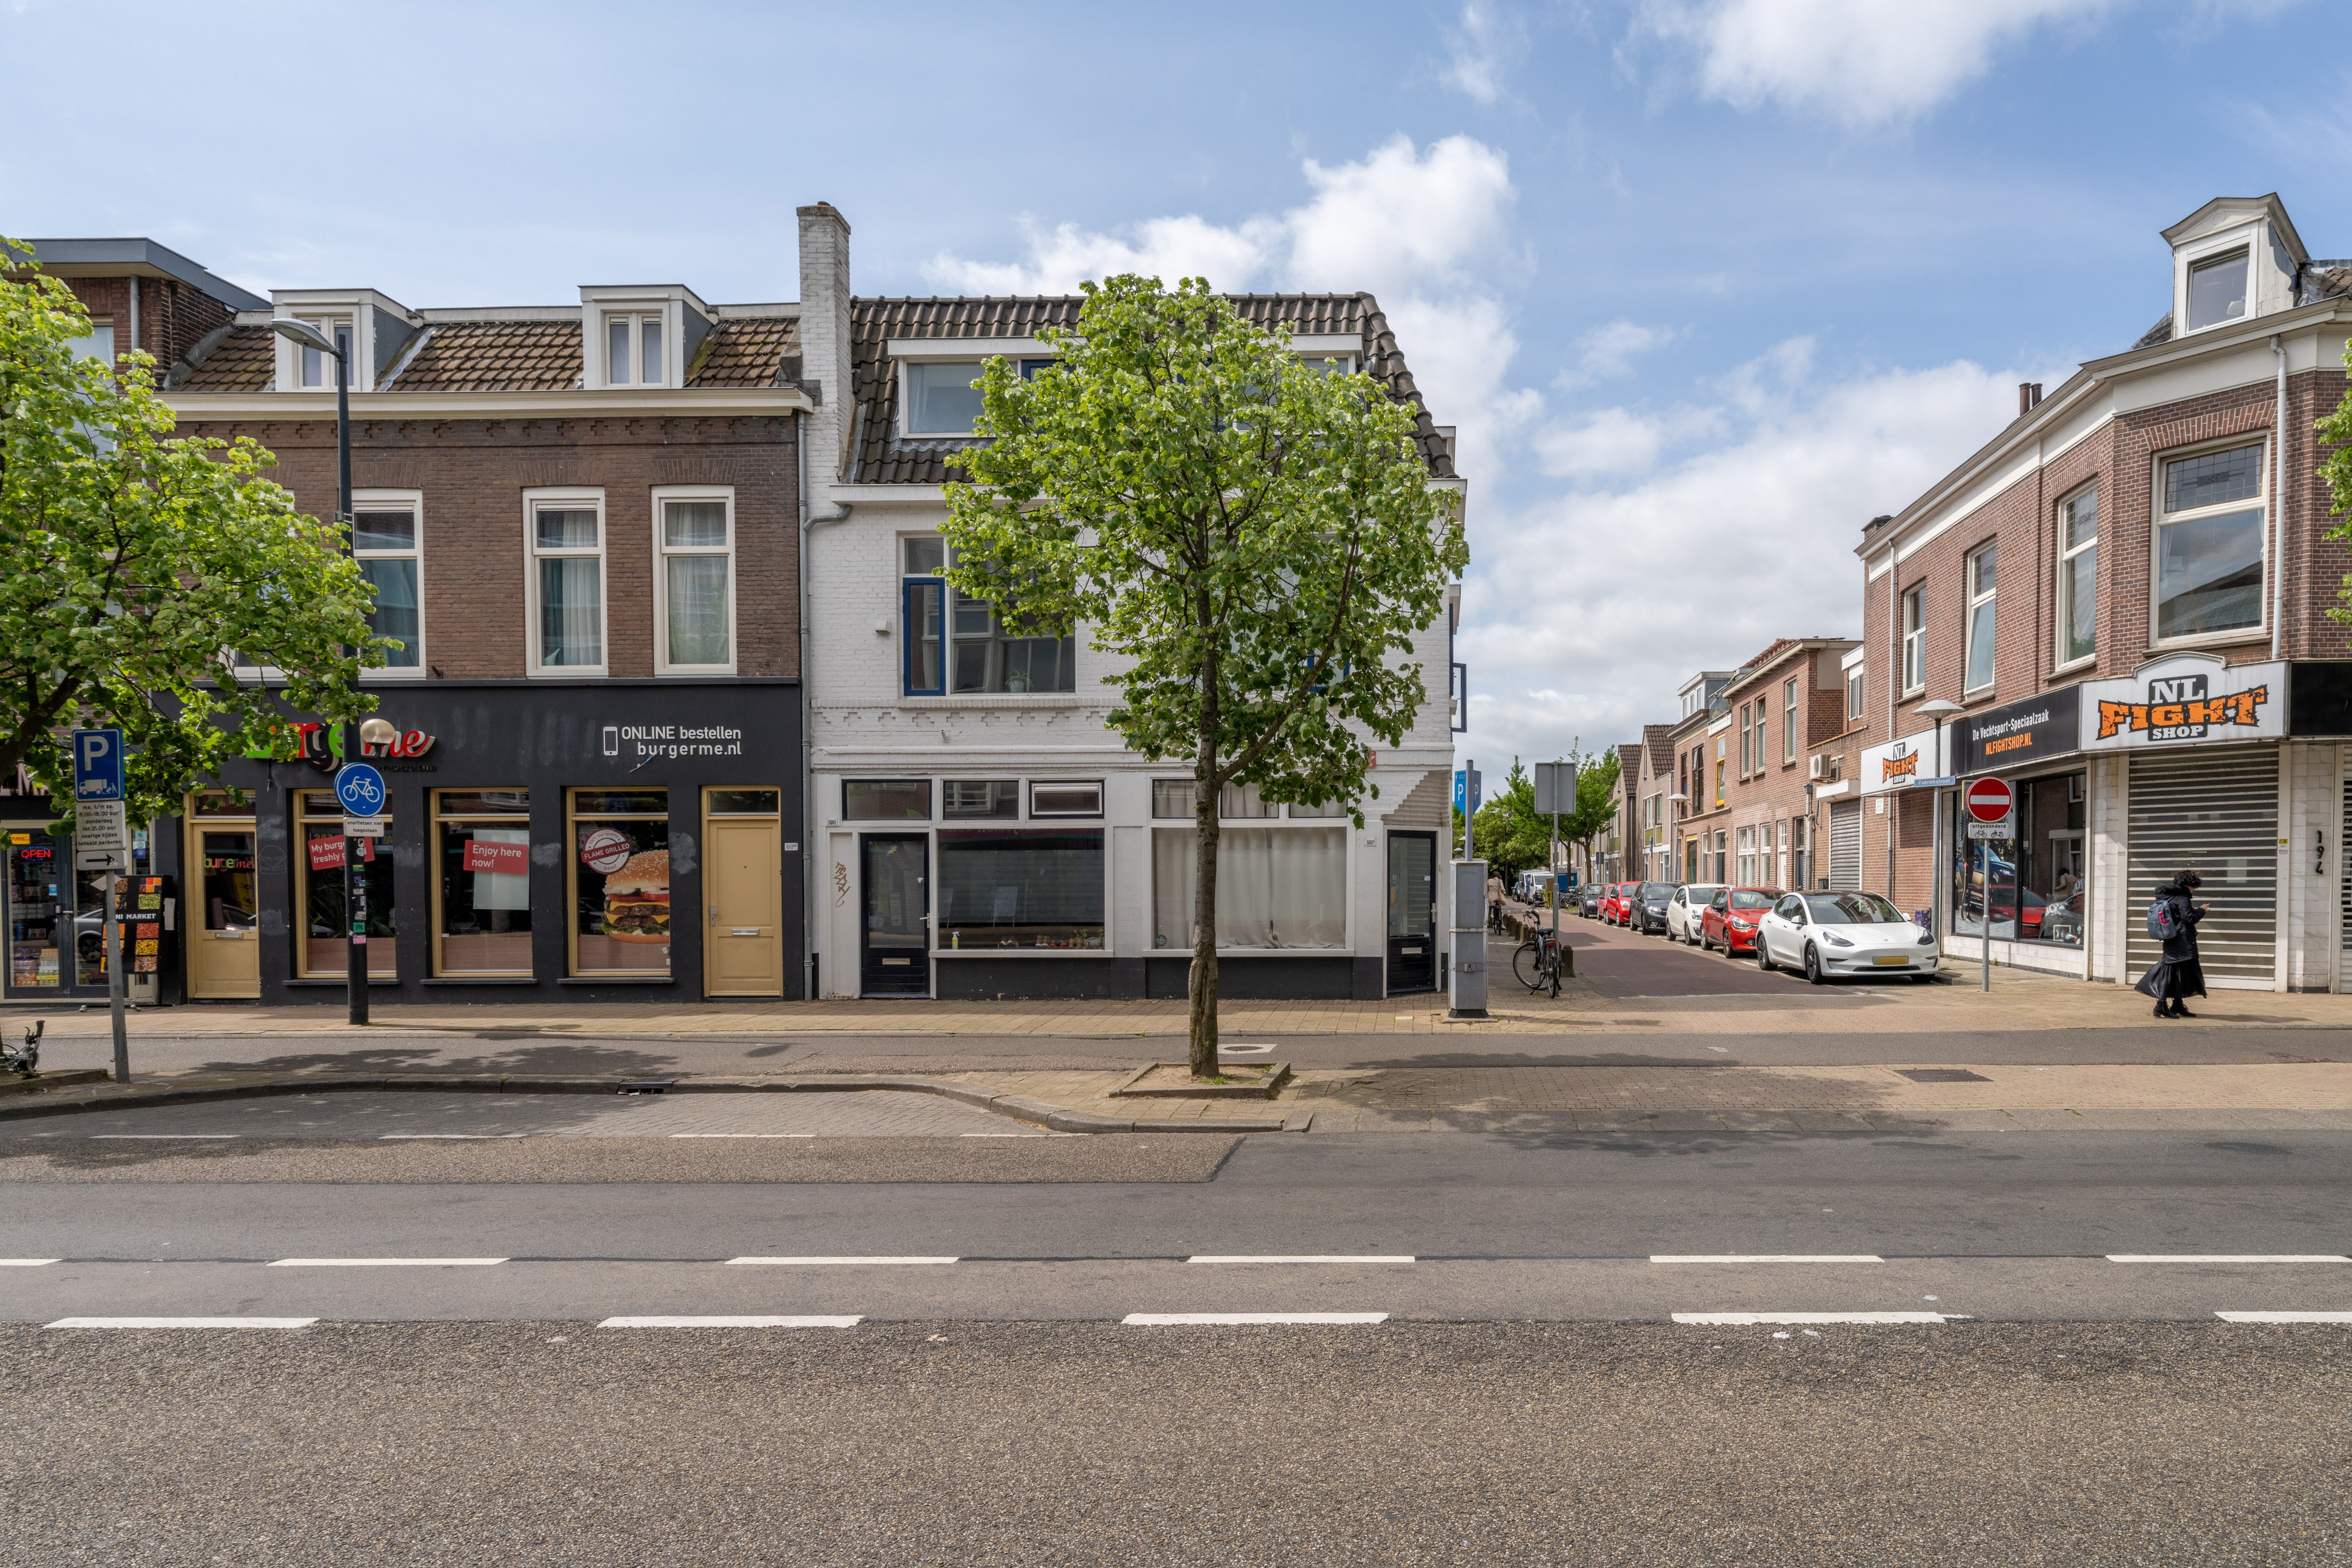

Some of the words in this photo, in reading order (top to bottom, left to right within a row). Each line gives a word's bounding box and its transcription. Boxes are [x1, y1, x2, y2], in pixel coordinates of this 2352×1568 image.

[2152, 678, 2204, 704] NL
[2097, 686, 2268, 739] FIGHT
[621, 726, 675, 740] ONLINE
[680, 726, 741, 739] bestellen
[1973, 729, 1979, 741] De
[1980, 709, 2049, 739] Vechtsport-Speciaalzaak
[2152, 725, 2204, 740] SHOP
[638, 741, 742, 758] burgerme.nl
[1986, 732, 2032, 755] NLFIGHTSHOP.NL
[84, 735, 109, 771] P
[1894, 744, 1905, 760] NL
[1883, 750, 1917, 783] FIGHT
[1894, 775, 1905, 783] SHOP
[1458, 784, 1463, 801] P
[1475, 784, 1479, 800] P
[21, 849, 51, 858] OPEN
[311, 845, 322, 853] My
[473, 845, 498, 857] Enjoy
[501, 847, 521, 857] here
[584, 850, 604, 859] FLAME
[605, 843, 629, 854] GRILLED
[314, 853, 339, 863] freshly
[471, 859, 494, 868] now!
